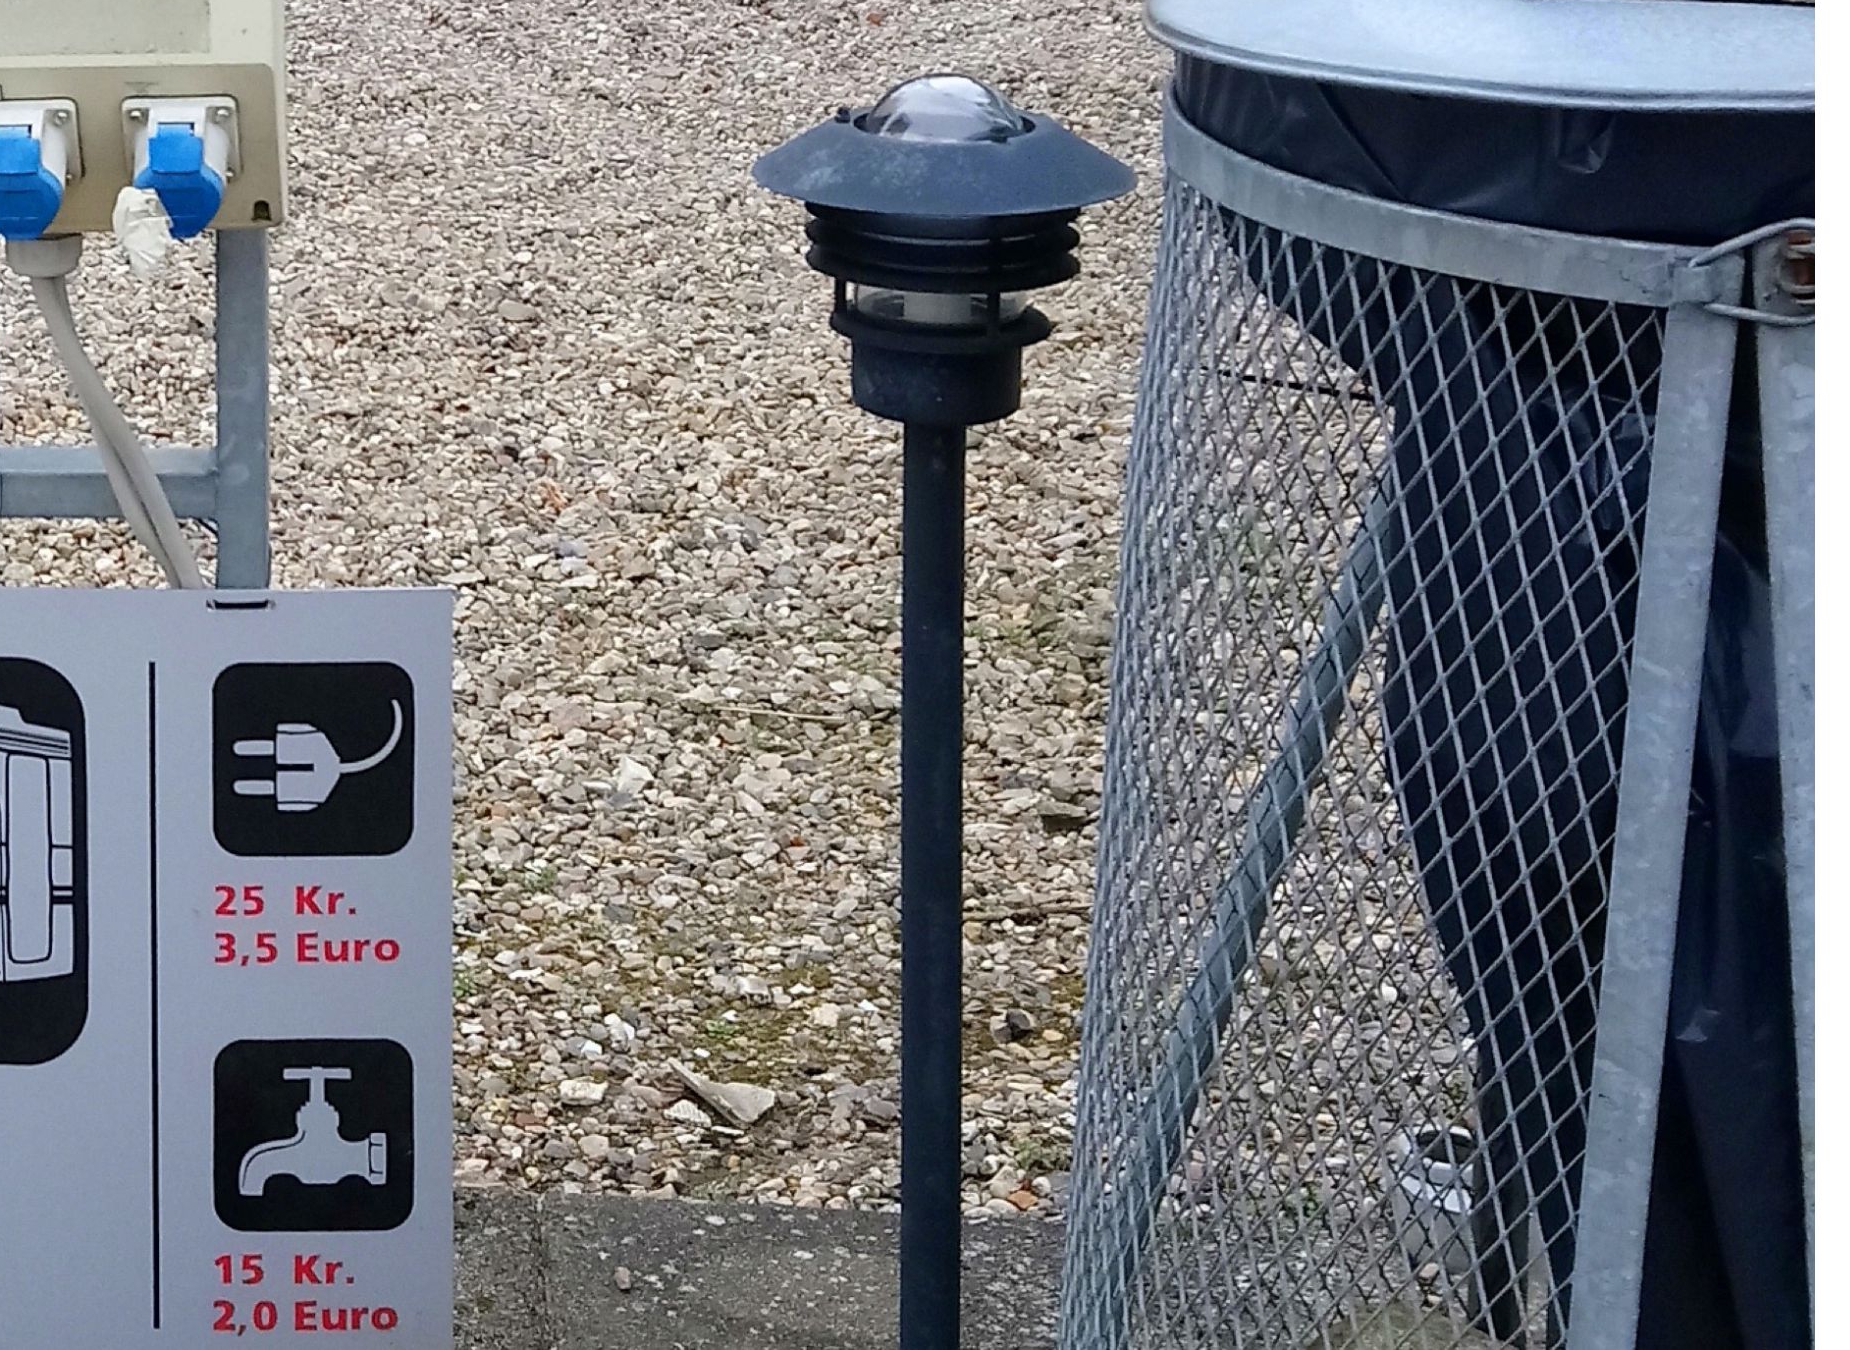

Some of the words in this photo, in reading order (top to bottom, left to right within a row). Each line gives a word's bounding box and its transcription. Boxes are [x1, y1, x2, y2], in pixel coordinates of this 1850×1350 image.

[215, 886, 264, 916] 25
[294, 886, 357, 916] Kr.
[215, 933, 278, 966] 3,5
[297, 933, 400, 964] Euro
[214, 1255, 264, 1285] 15
[294, 1255, 354, 1285] Kr.
[213, 1301, 278, 1336] 2,0
[294, 1301, 398, 1331] Euro
